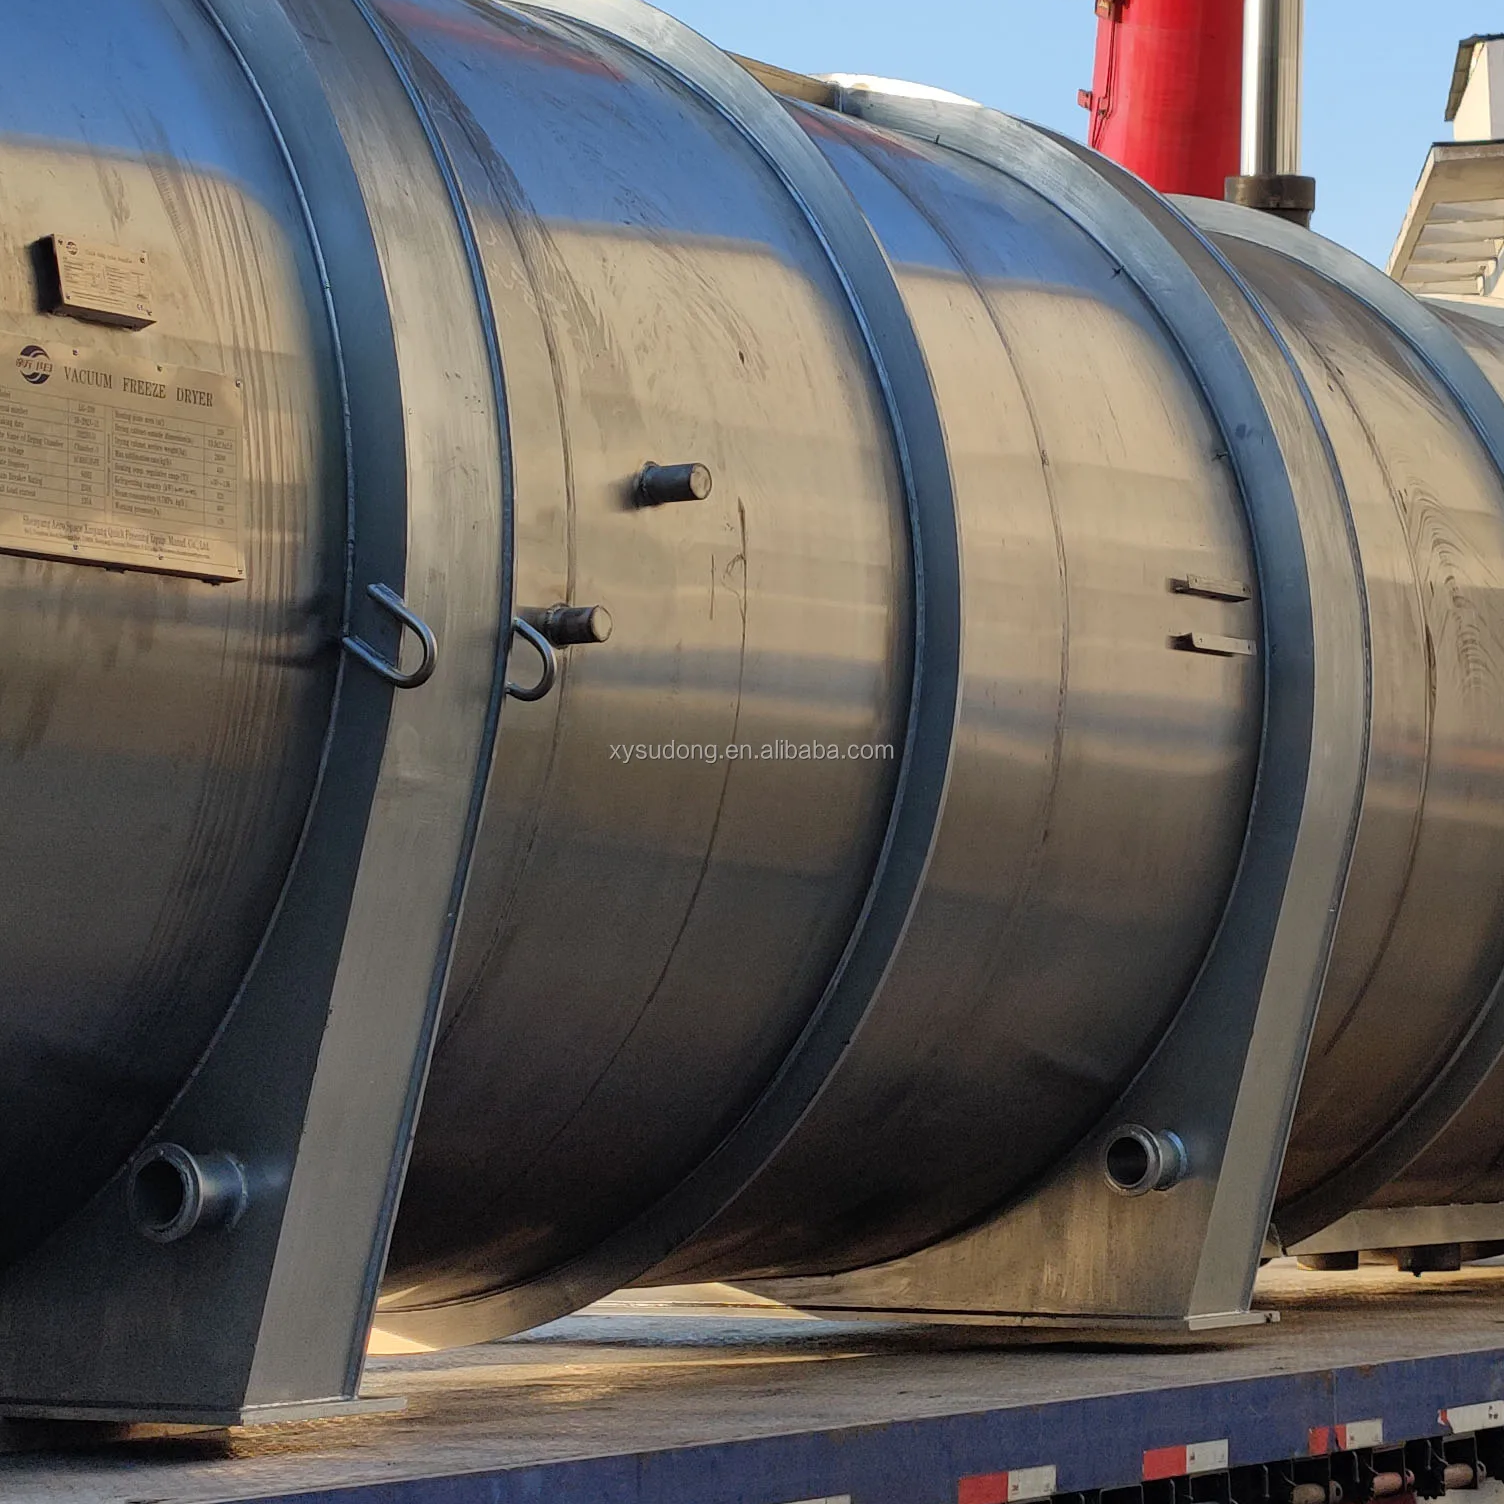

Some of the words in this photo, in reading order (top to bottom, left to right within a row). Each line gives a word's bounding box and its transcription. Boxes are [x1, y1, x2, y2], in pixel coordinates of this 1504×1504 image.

[63, 366, 113, 390] VACUUM
[123, 377, 167, 399] FREEZE
[176, 387, 214, 408] DRYER
